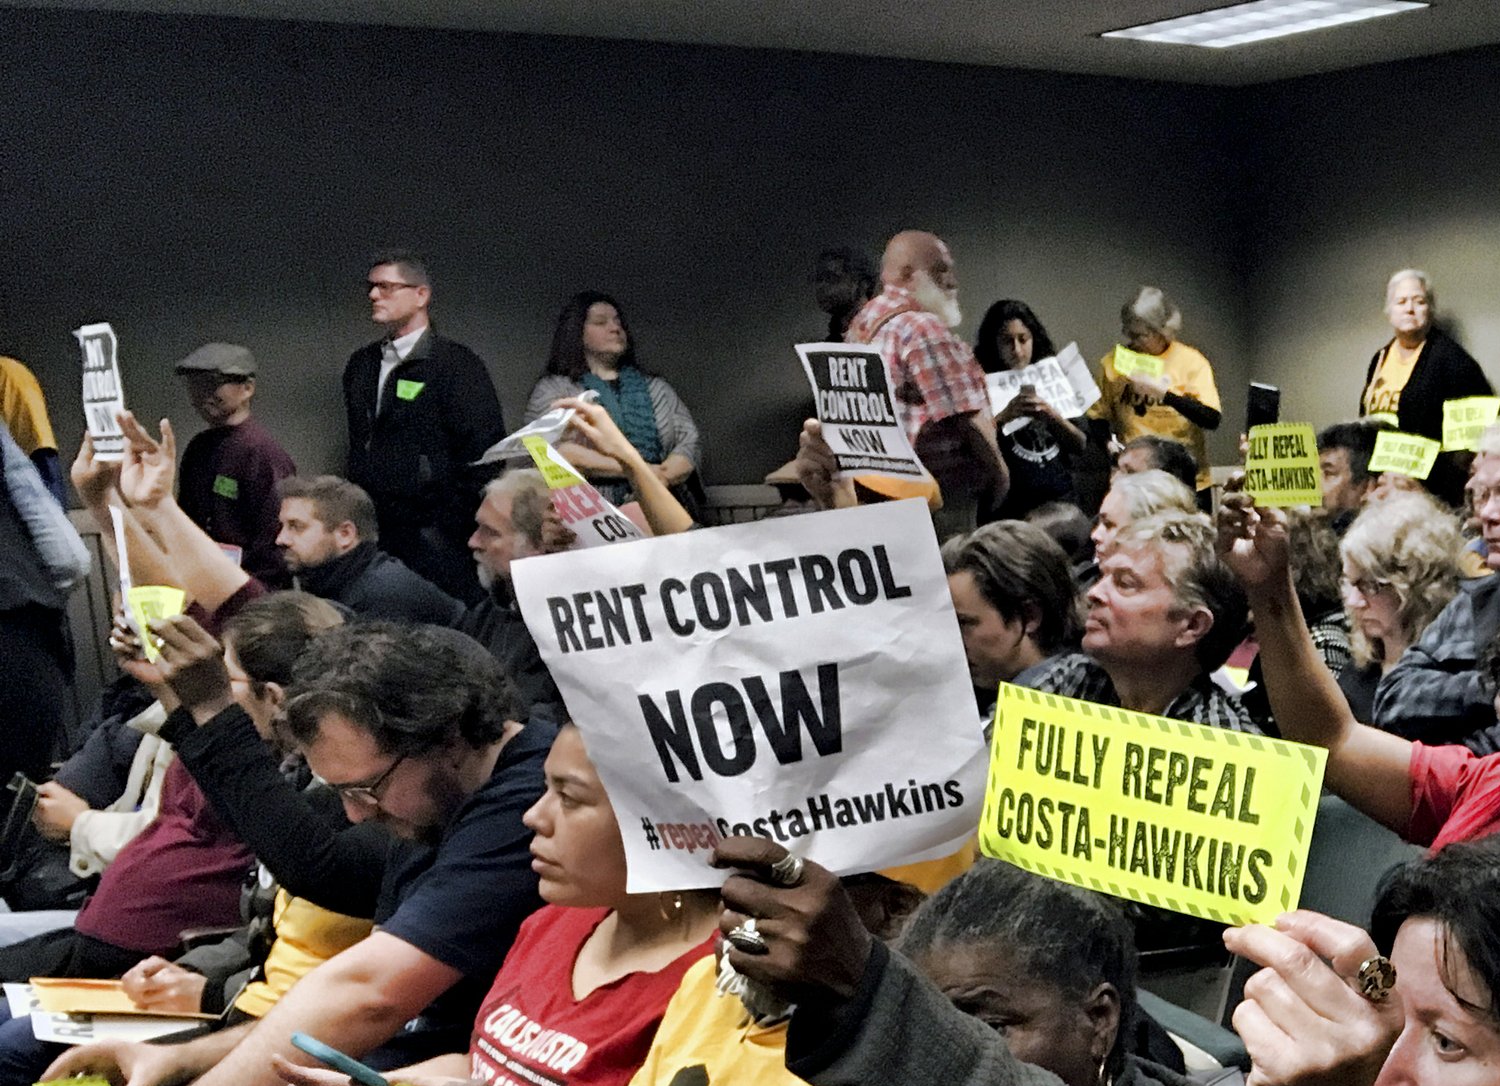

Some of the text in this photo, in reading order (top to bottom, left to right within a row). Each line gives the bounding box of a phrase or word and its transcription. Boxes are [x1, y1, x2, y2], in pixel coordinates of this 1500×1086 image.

[828, 356, 867, 388] RENT
[820, 389, 894, 422] CONTROL
[838, 428, 887, 455] NOW
[1273, 434, 1308, 459] REPEAL
[1244, 466, 1316, 491] OSTA-HAWKINS
[546, 544, 912, 653] RENT CONTROL
[638, 662, 843, 783] NOW
[1017, 718, 1260, 825] FULLY REPEAL
[997, 788, 1273, 905] COSTA-HAWKINS
